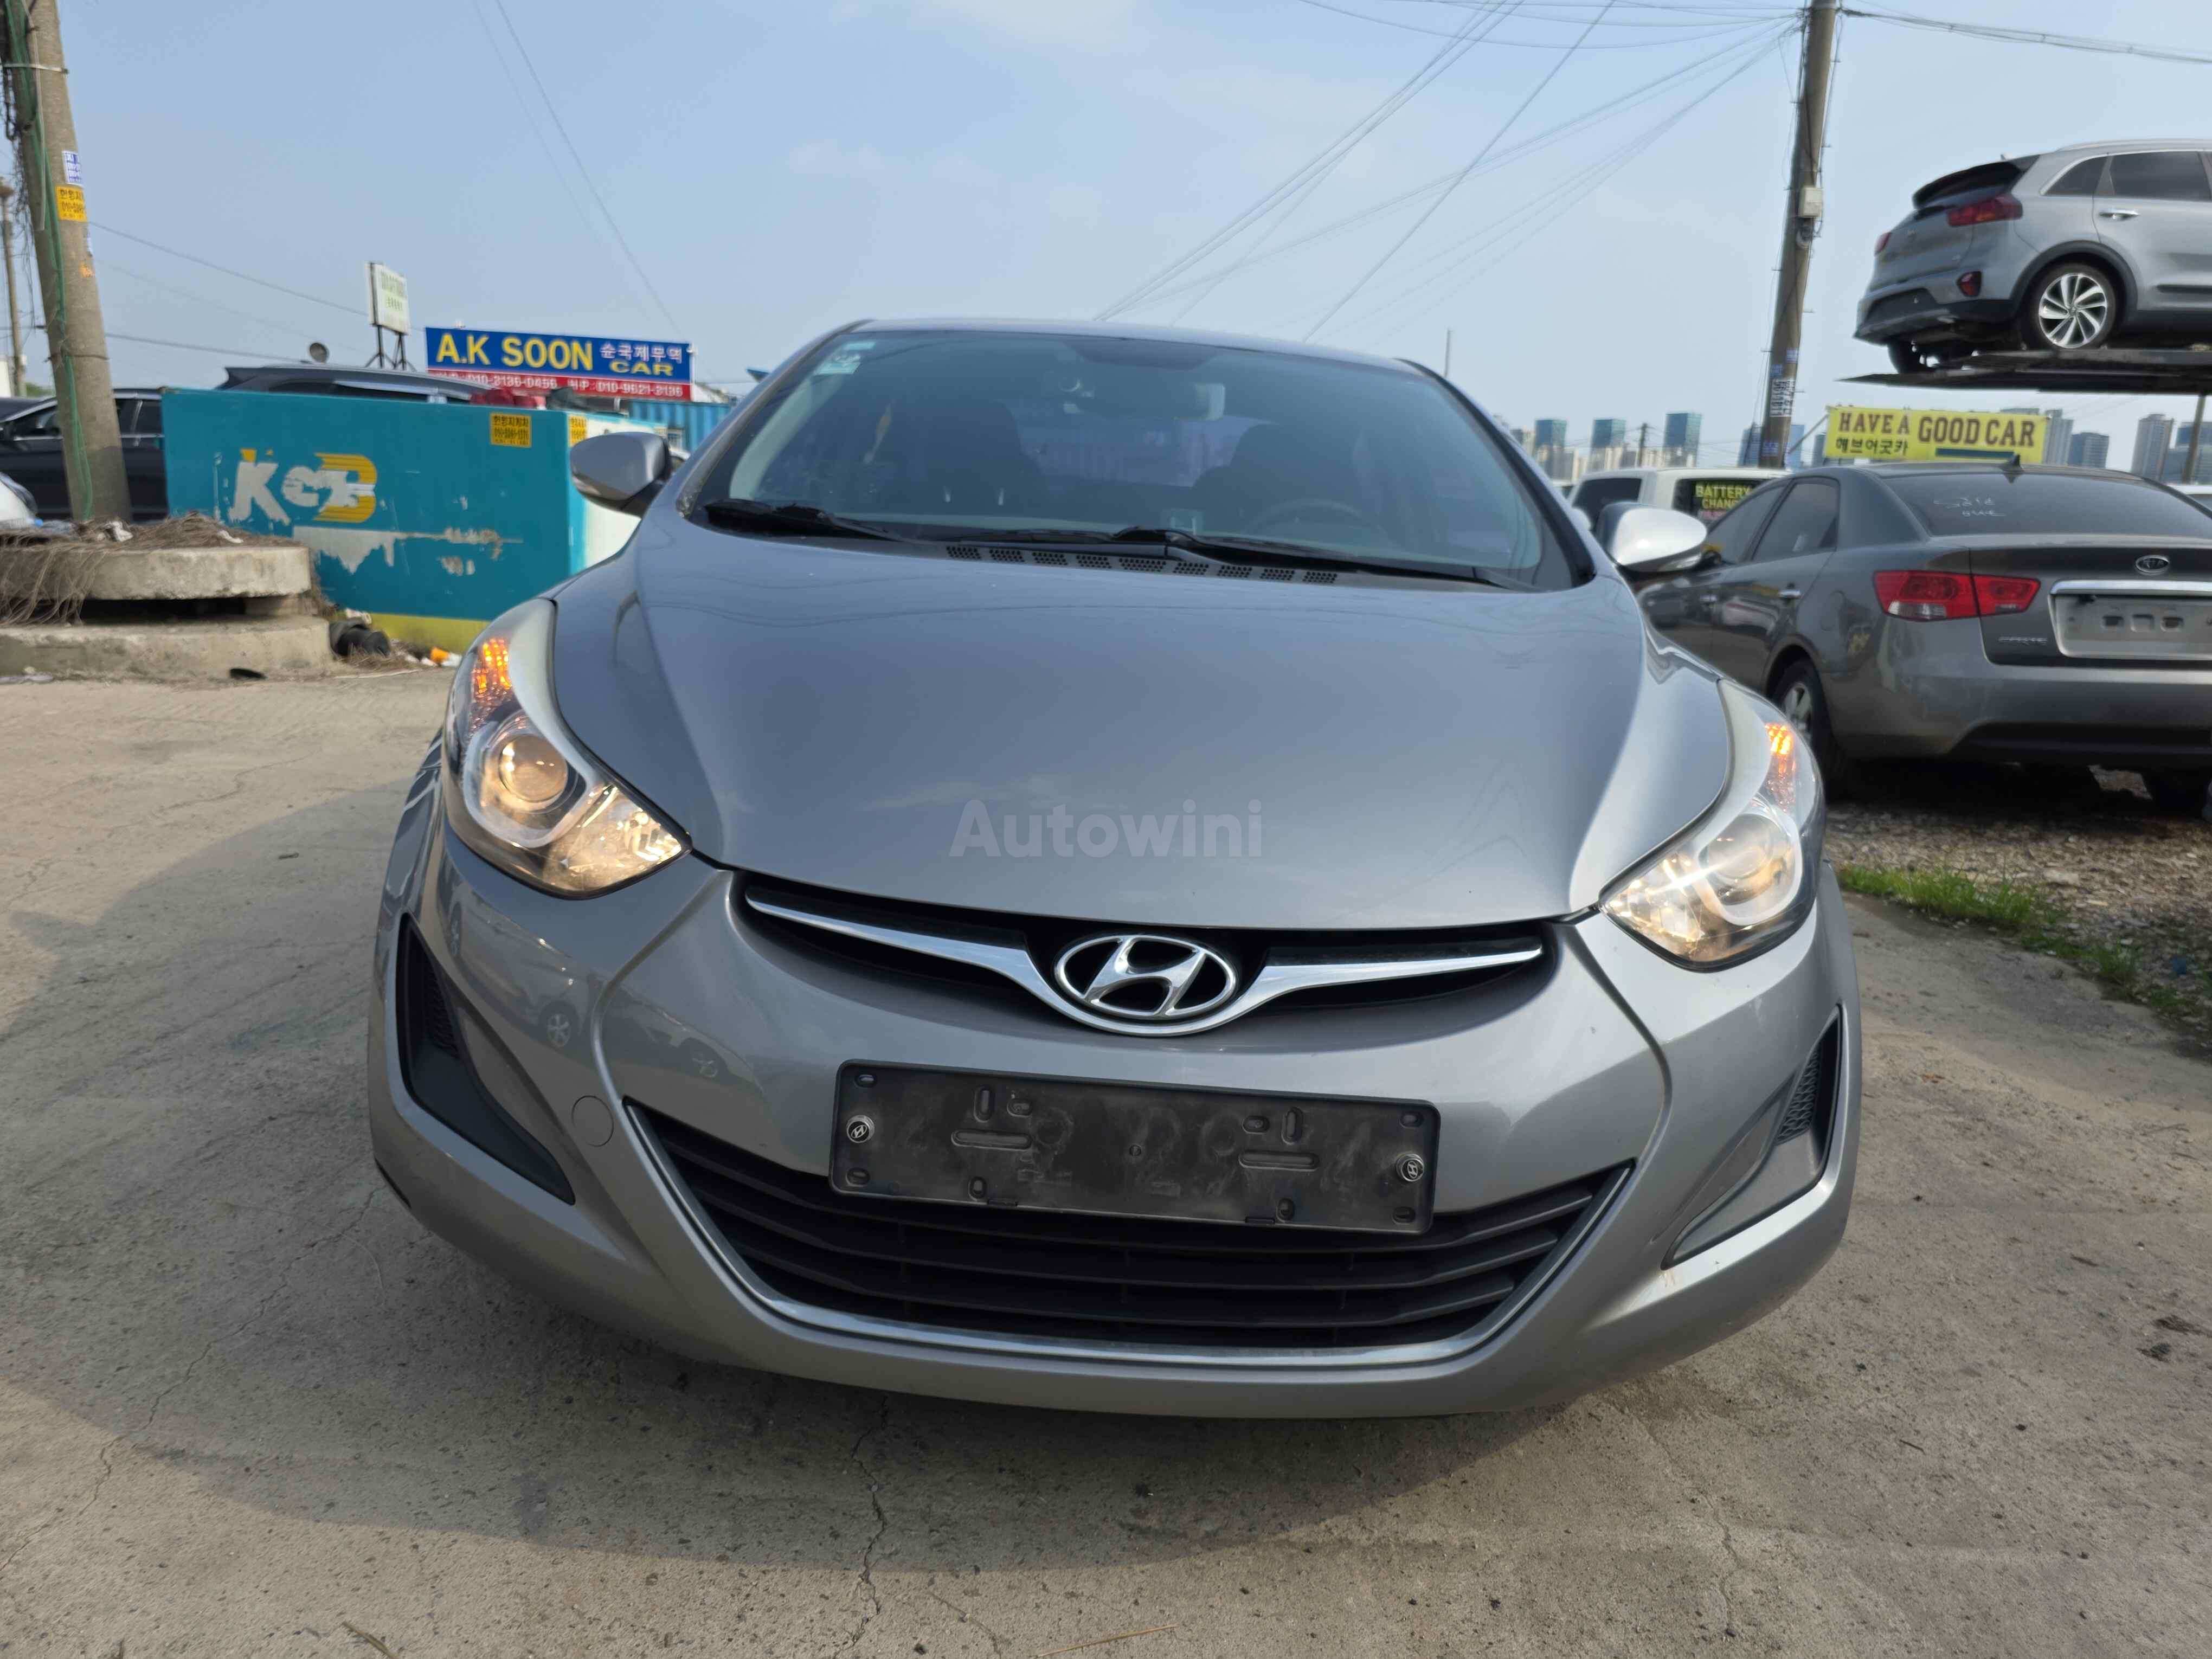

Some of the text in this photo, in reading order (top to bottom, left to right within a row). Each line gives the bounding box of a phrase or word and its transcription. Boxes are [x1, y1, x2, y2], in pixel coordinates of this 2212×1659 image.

[501, 336, 593, 371] SOON
[609, 359, 673, 376] CAR
[1838, 412, 2035, 447] HAVE A GOOD CAR
[1695, 484, 1752, 499] BATTERY
